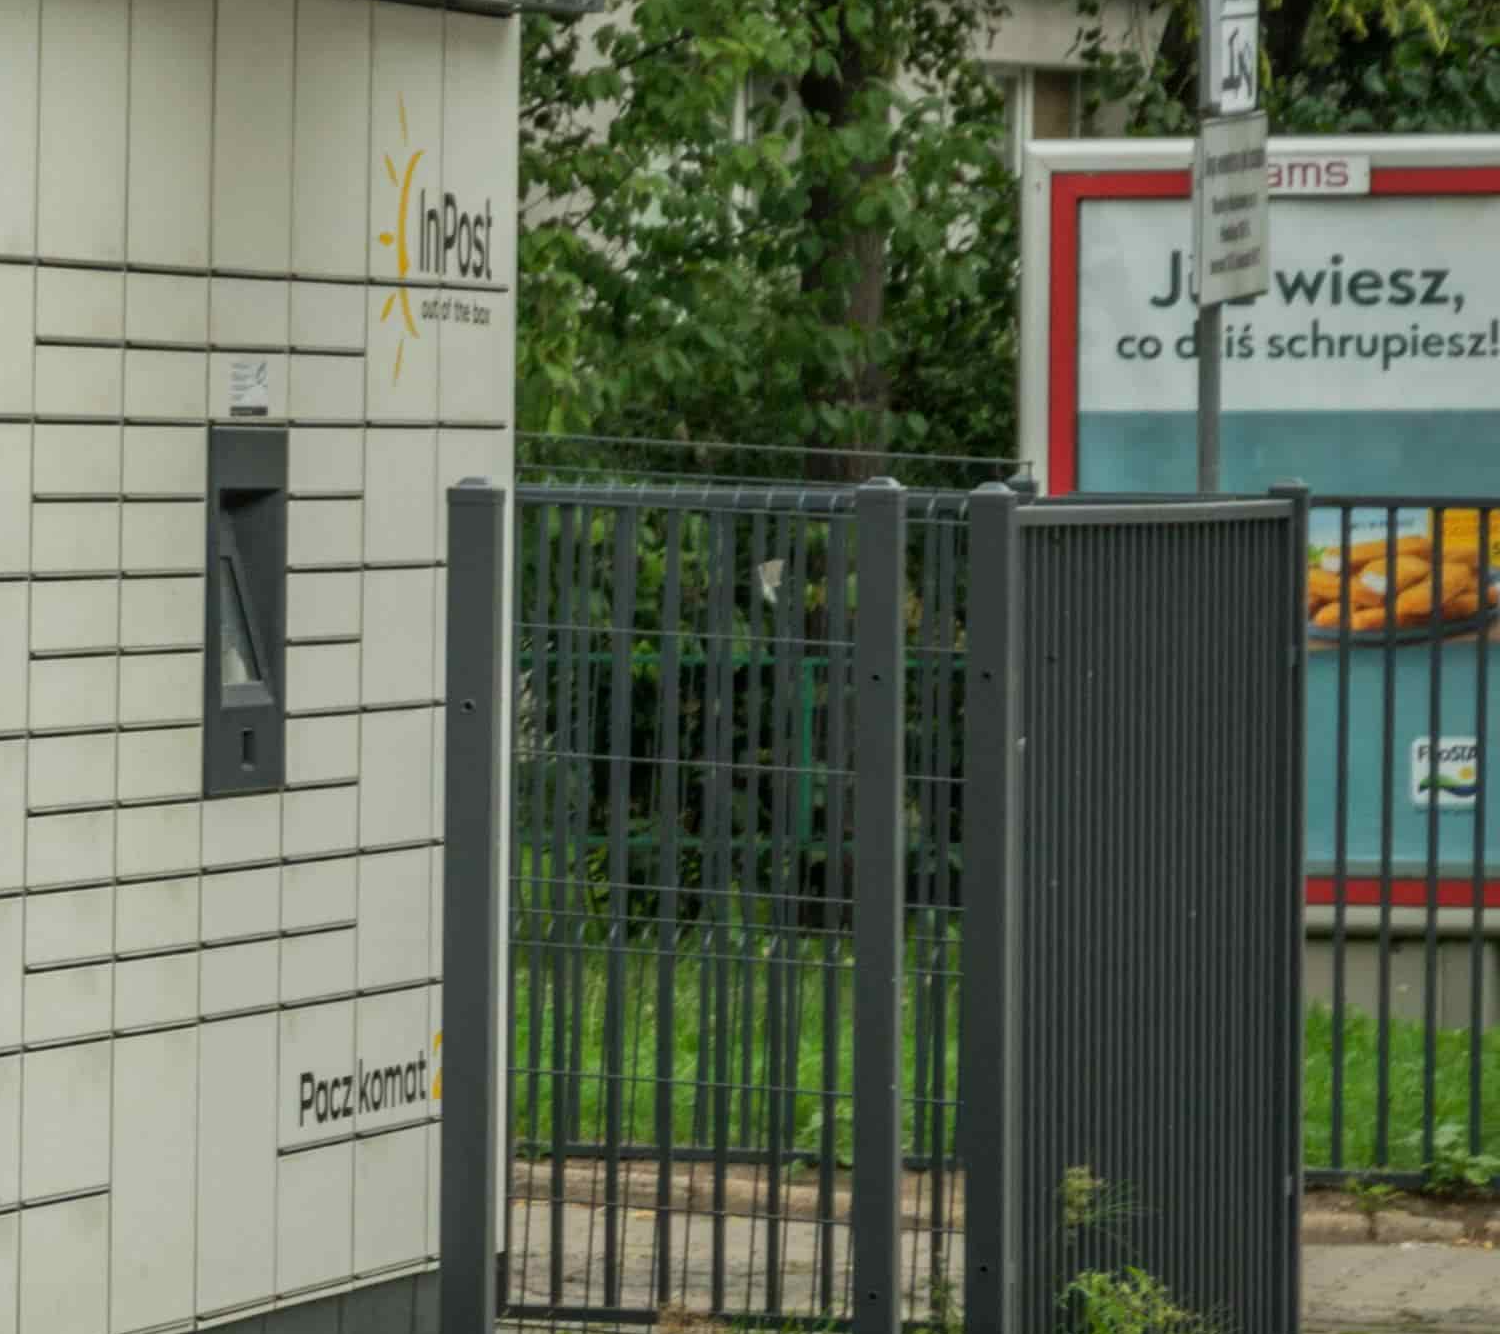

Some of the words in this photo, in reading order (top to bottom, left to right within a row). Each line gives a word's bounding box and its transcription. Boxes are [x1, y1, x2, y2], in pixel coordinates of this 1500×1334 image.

[420, 189, 492, 281] InPost
[1275, 254, 1465, 314] wiesz,
[1116, 334, 1163, 359] co
[1175, 320, 1256, 359] diś
[1267, 318, 1499, 371] schrupiesz!
